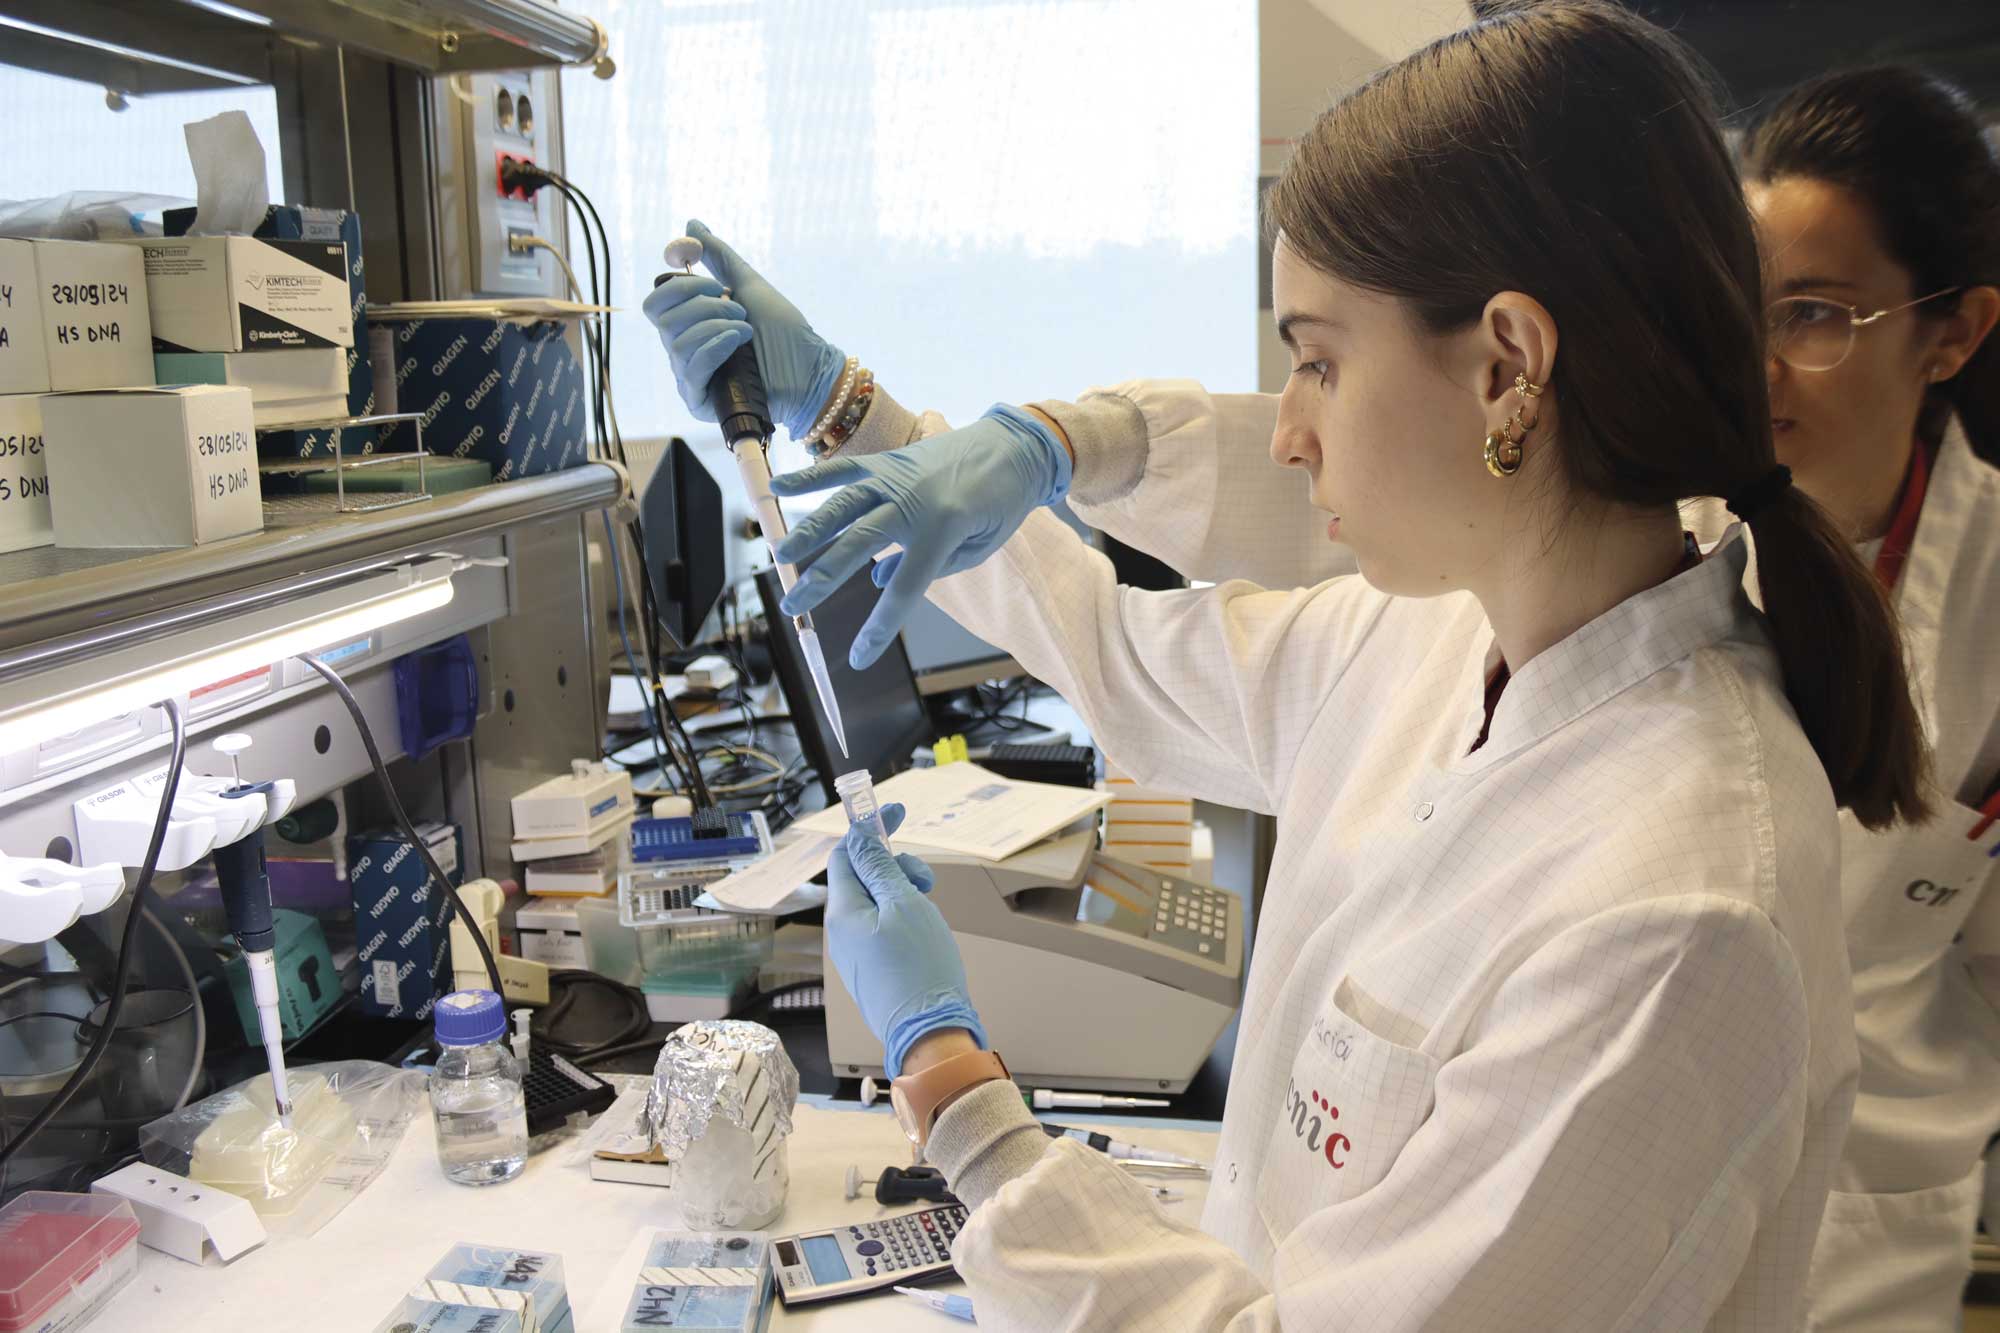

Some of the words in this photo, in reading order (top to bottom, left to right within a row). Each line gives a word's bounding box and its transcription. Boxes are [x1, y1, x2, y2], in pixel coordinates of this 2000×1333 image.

[266, 278, 303, 287] KIMTECH
[57, 325, 80, 345] HS
[88, 322, 120, 343] DNA
[432, 334, 468, 376] QIAGEN
[465, 368, 501, 411] QIAGEN
[498, 401, 520, 444] QIAGEN
[198, 431, 248, 457] 28/05/24
[209, 473, 225, 500] HS
[228, 467, 249, 493] DNA
[96, 787, 125, 804] GILSON
[383, 842, 414, 874] QIAGEN
[369, 886, 400, 919] QIAGEN
[358, 929, 388, 962] QIAGEN
[398, 916, 430, 949] QIAGEN
[633, 1286, 677, 1326] N42
